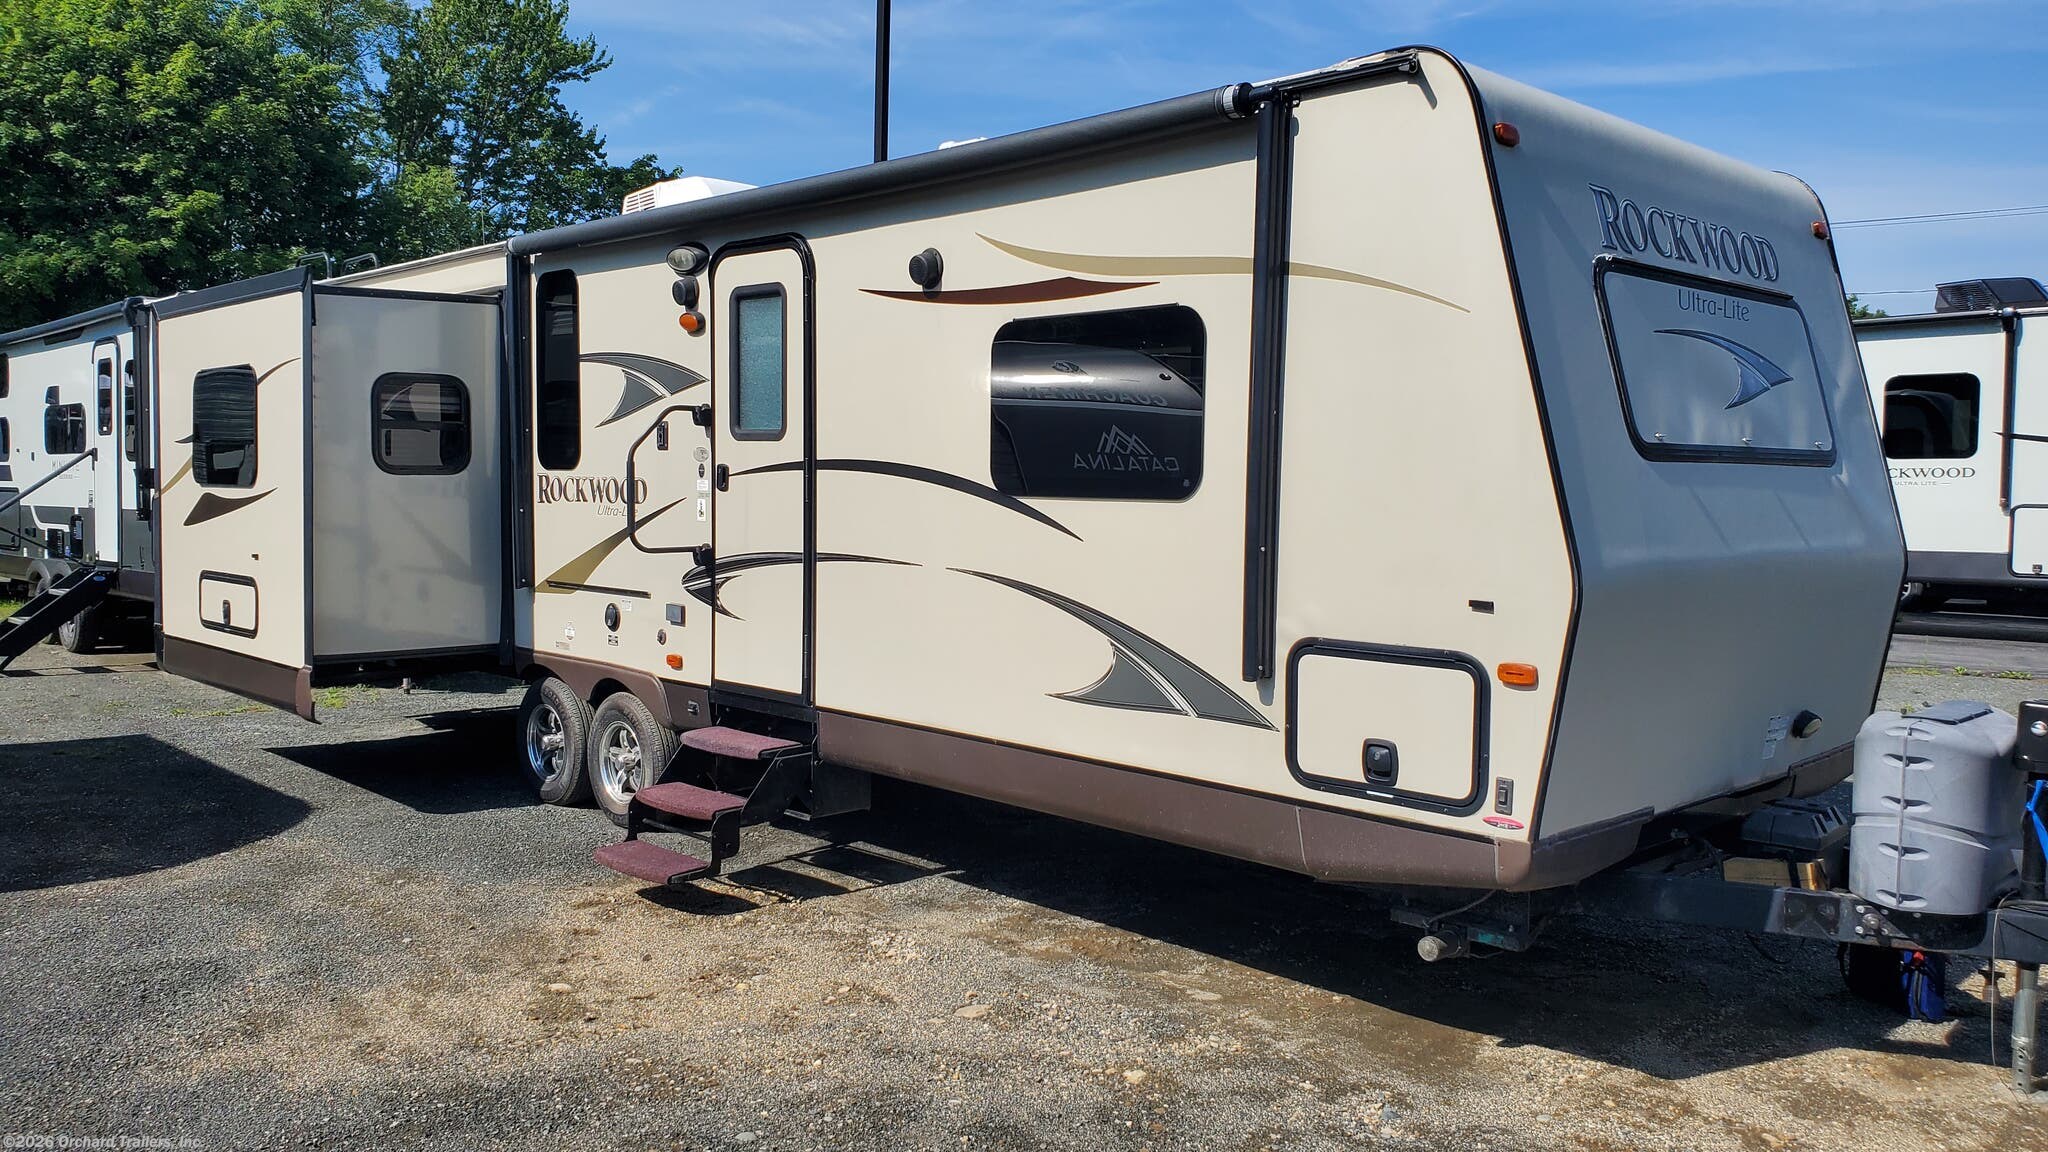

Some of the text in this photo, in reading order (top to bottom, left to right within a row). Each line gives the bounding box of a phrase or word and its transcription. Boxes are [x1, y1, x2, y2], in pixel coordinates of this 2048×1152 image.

[1588, 182, 1779, 282] ROCKWOOD
[1677, 289, 1750, 322] Ultra-Lite
[1888, 467, 1975, 478] CKWOOD
